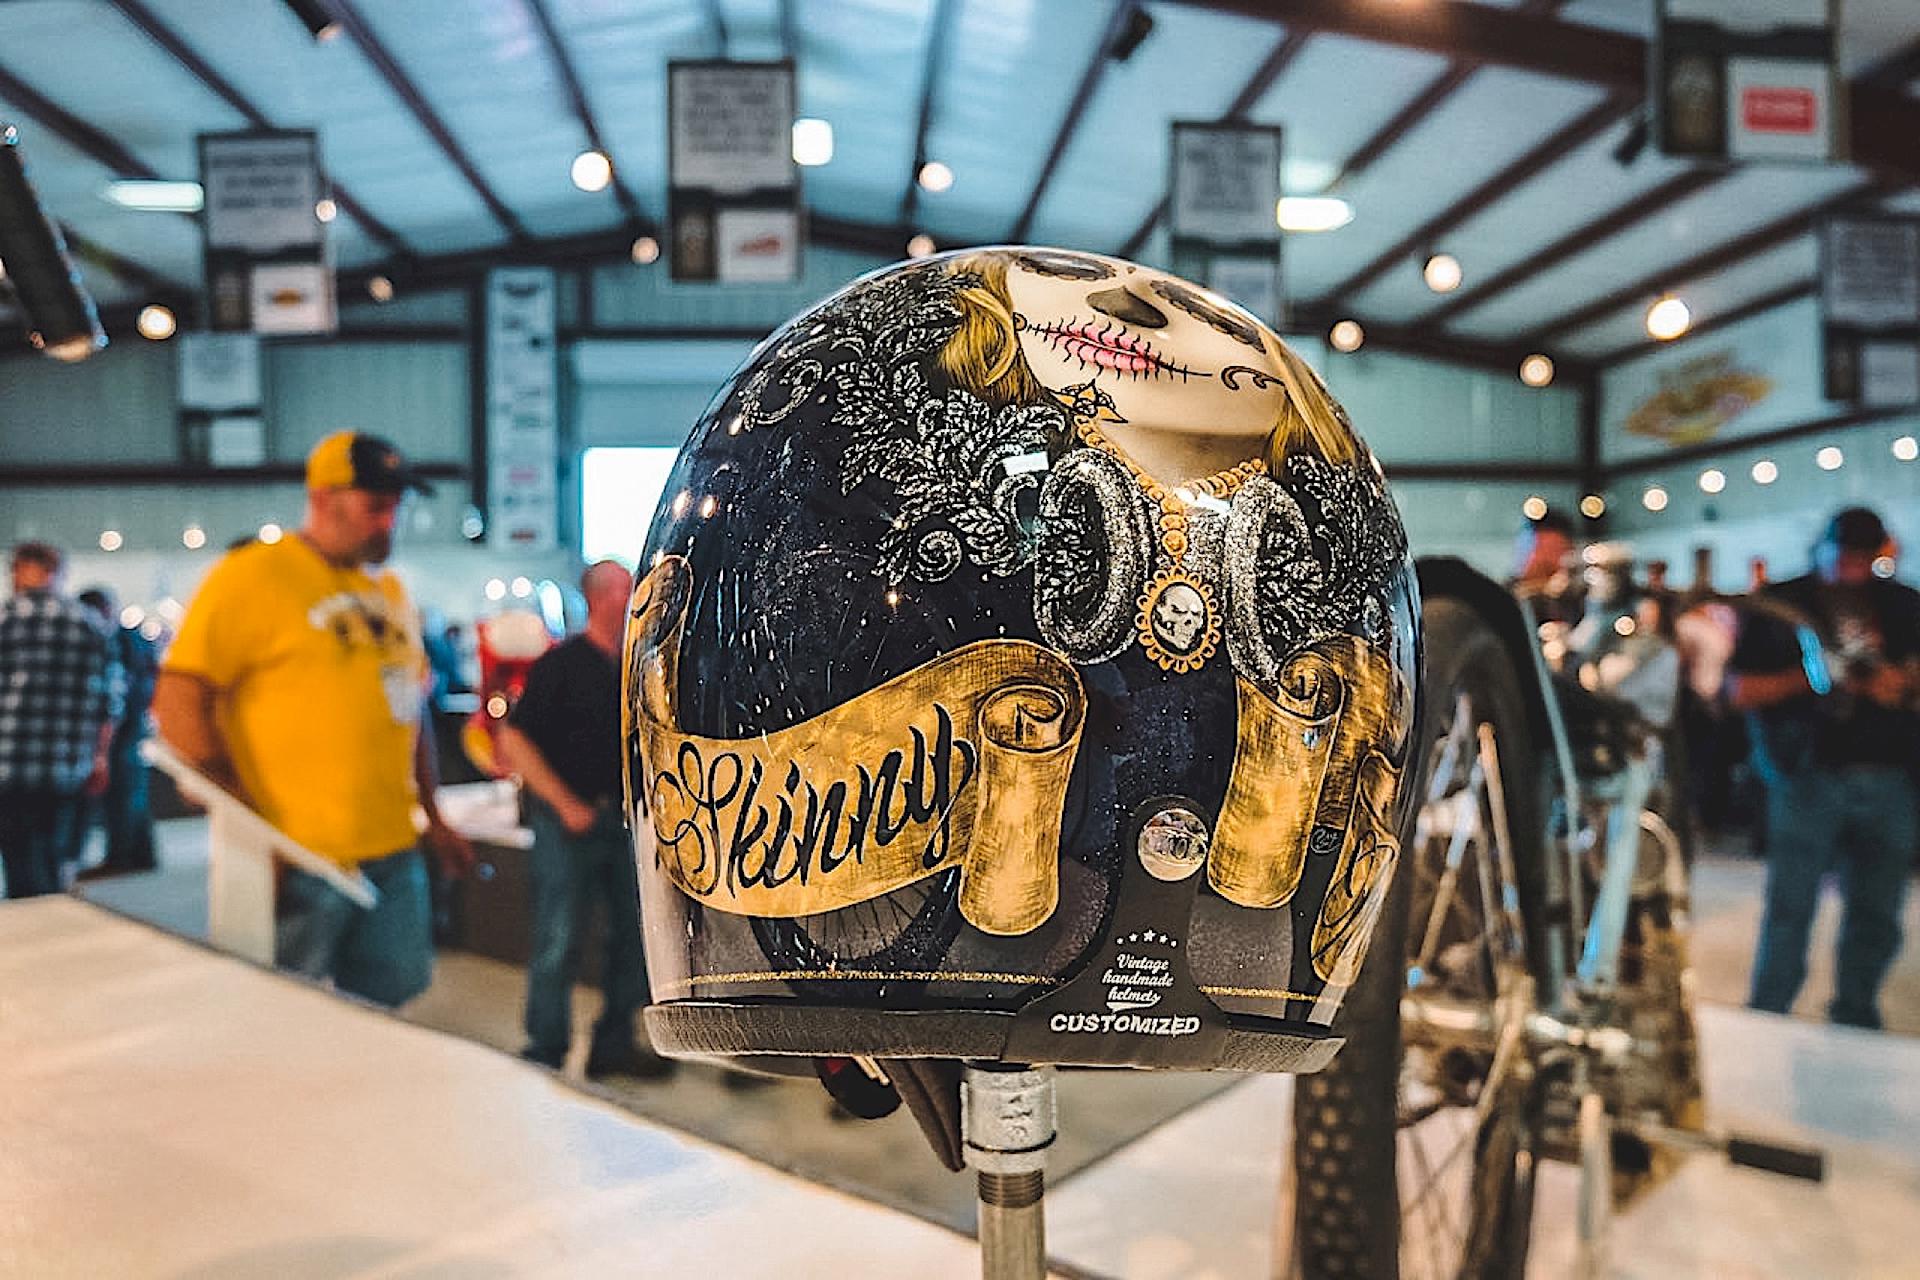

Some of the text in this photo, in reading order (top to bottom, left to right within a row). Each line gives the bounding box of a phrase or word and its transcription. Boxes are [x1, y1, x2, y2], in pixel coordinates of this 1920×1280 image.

[653, 702, 976, 899] Skinny
[1117, 954, 1170, 974] Vintage
[1102, 969, 1174, 987] handmade
[1107, 986, 1161, 1006] helmets
[1050, 1013, 1200, 1036] CUSTOMIZED
